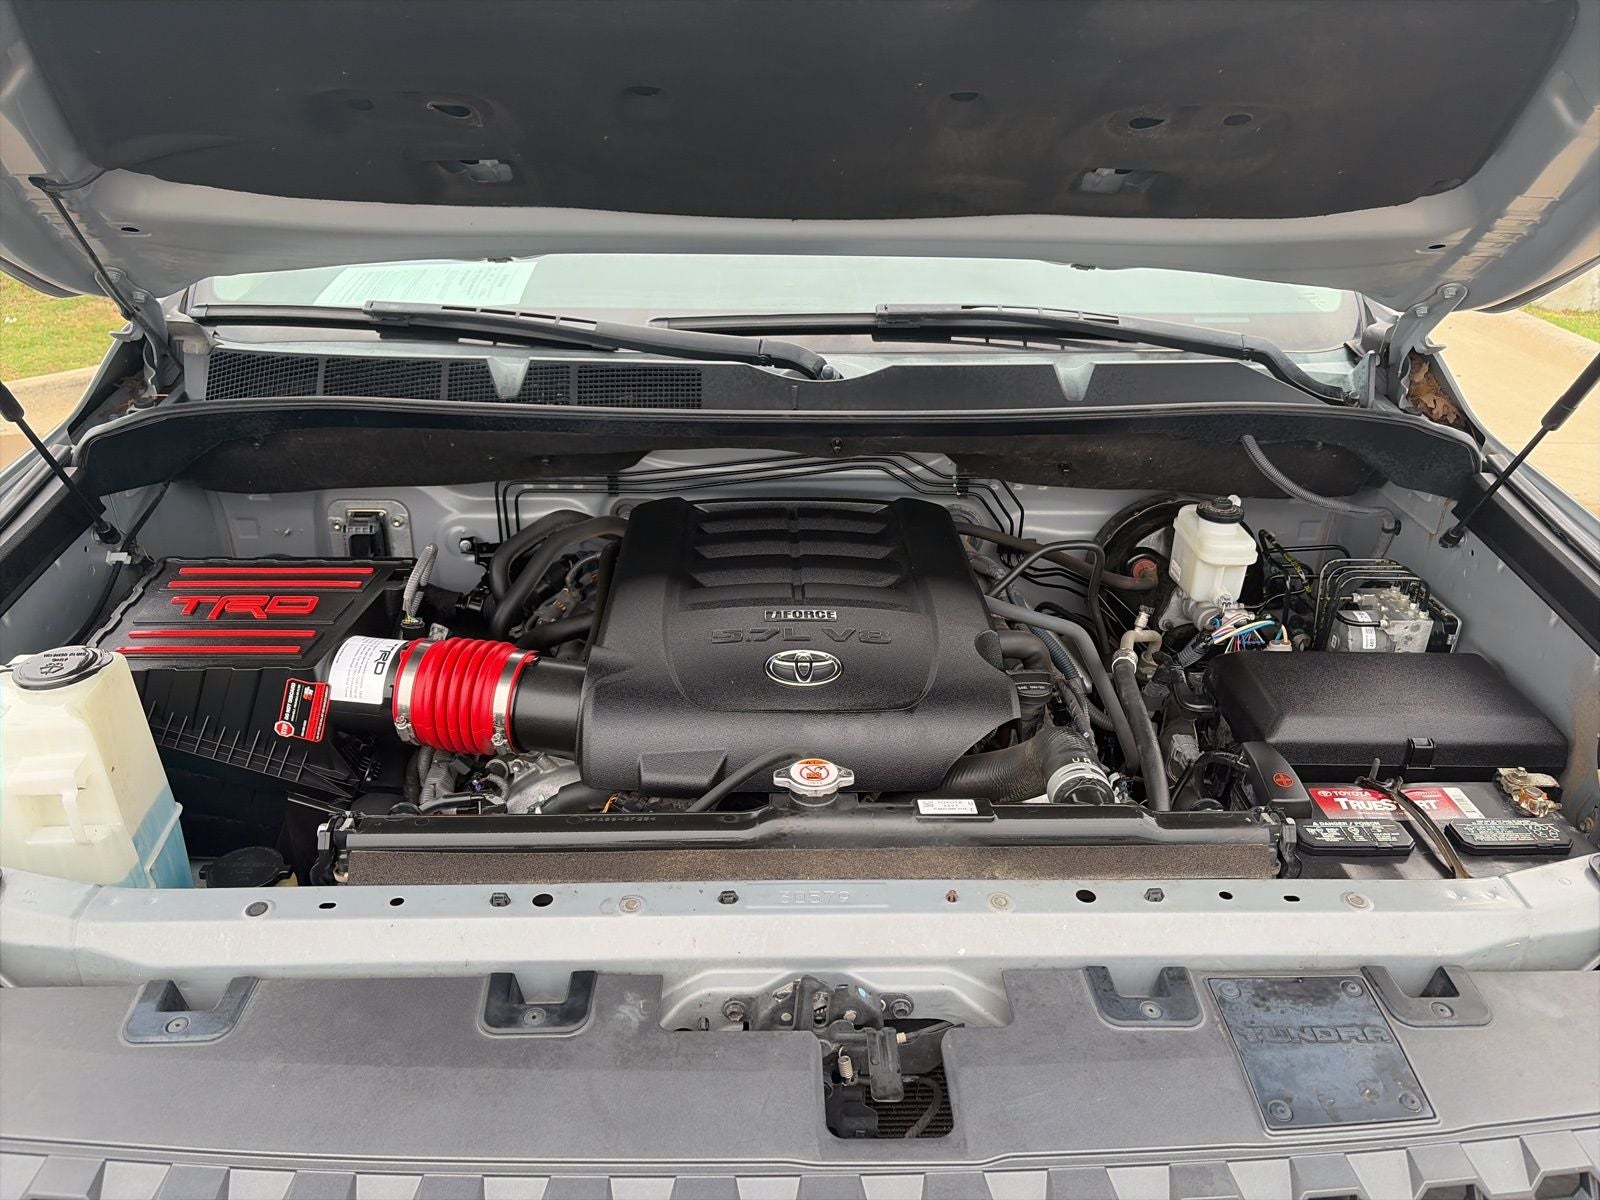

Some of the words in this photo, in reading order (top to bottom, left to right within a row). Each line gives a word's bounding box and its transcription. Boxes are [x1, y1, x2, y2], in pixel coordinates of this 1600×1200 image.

[170, 595, 319, 620] TRD
[821, 627, 893, 644] V8
[374, 643, 399, 676] TRD
[1332, 790, 1372, 798] TOYOTA
[1236, 1024, 1394, 1044] TUNDRA
